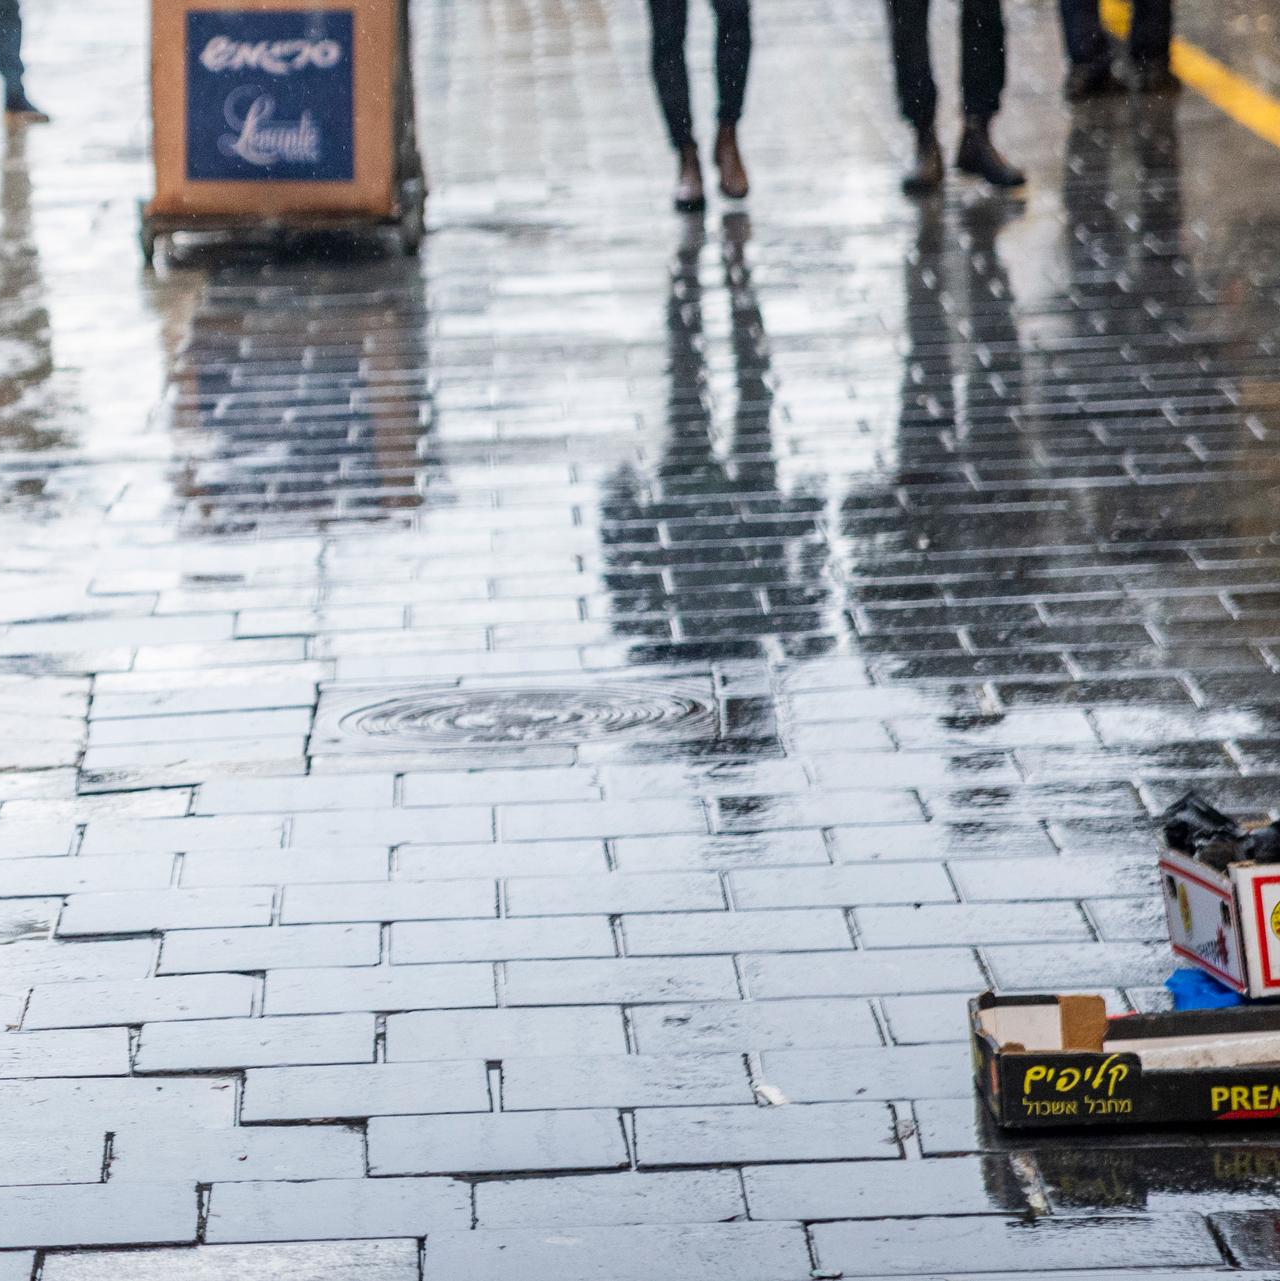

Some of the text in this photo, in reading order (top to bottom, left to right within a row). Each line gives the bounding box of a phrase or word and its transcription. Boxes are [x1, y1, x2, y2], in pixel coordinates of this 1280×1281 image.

[1023, 1053, 1130, 1096] קליפים
[1021, 1095, 1133, 1116] מחבל אשכול
